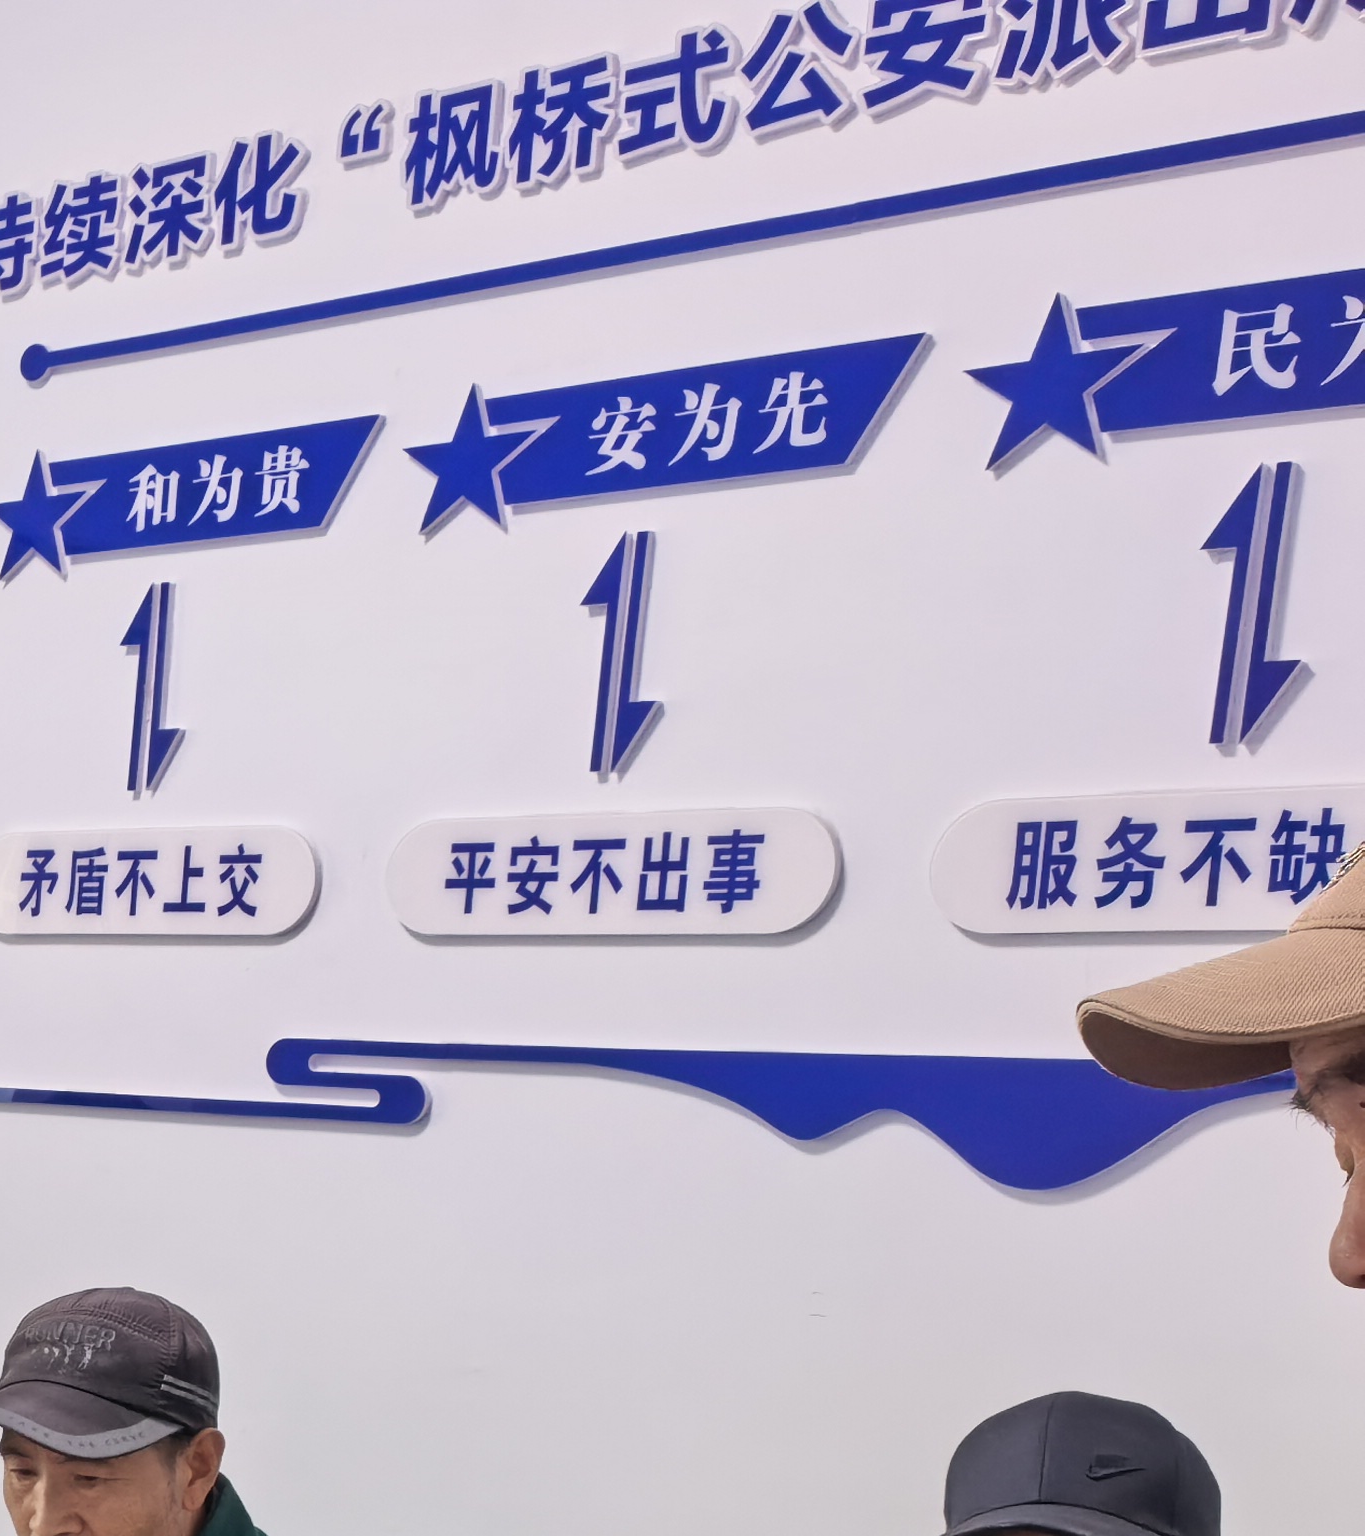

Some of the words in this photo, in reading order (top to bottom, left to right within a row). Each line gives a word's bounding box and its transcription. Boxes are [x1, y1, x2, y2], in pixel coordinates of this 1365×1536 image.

[585, 371, 829, 477] 安为先
[127, 444, 310, 532] 和为贵
[19, 845, 263, 917] 矛盾不上交
[446, 830, 766, 914] 平安不出事
[1007, 808, 1347, 909] 服务不缺
